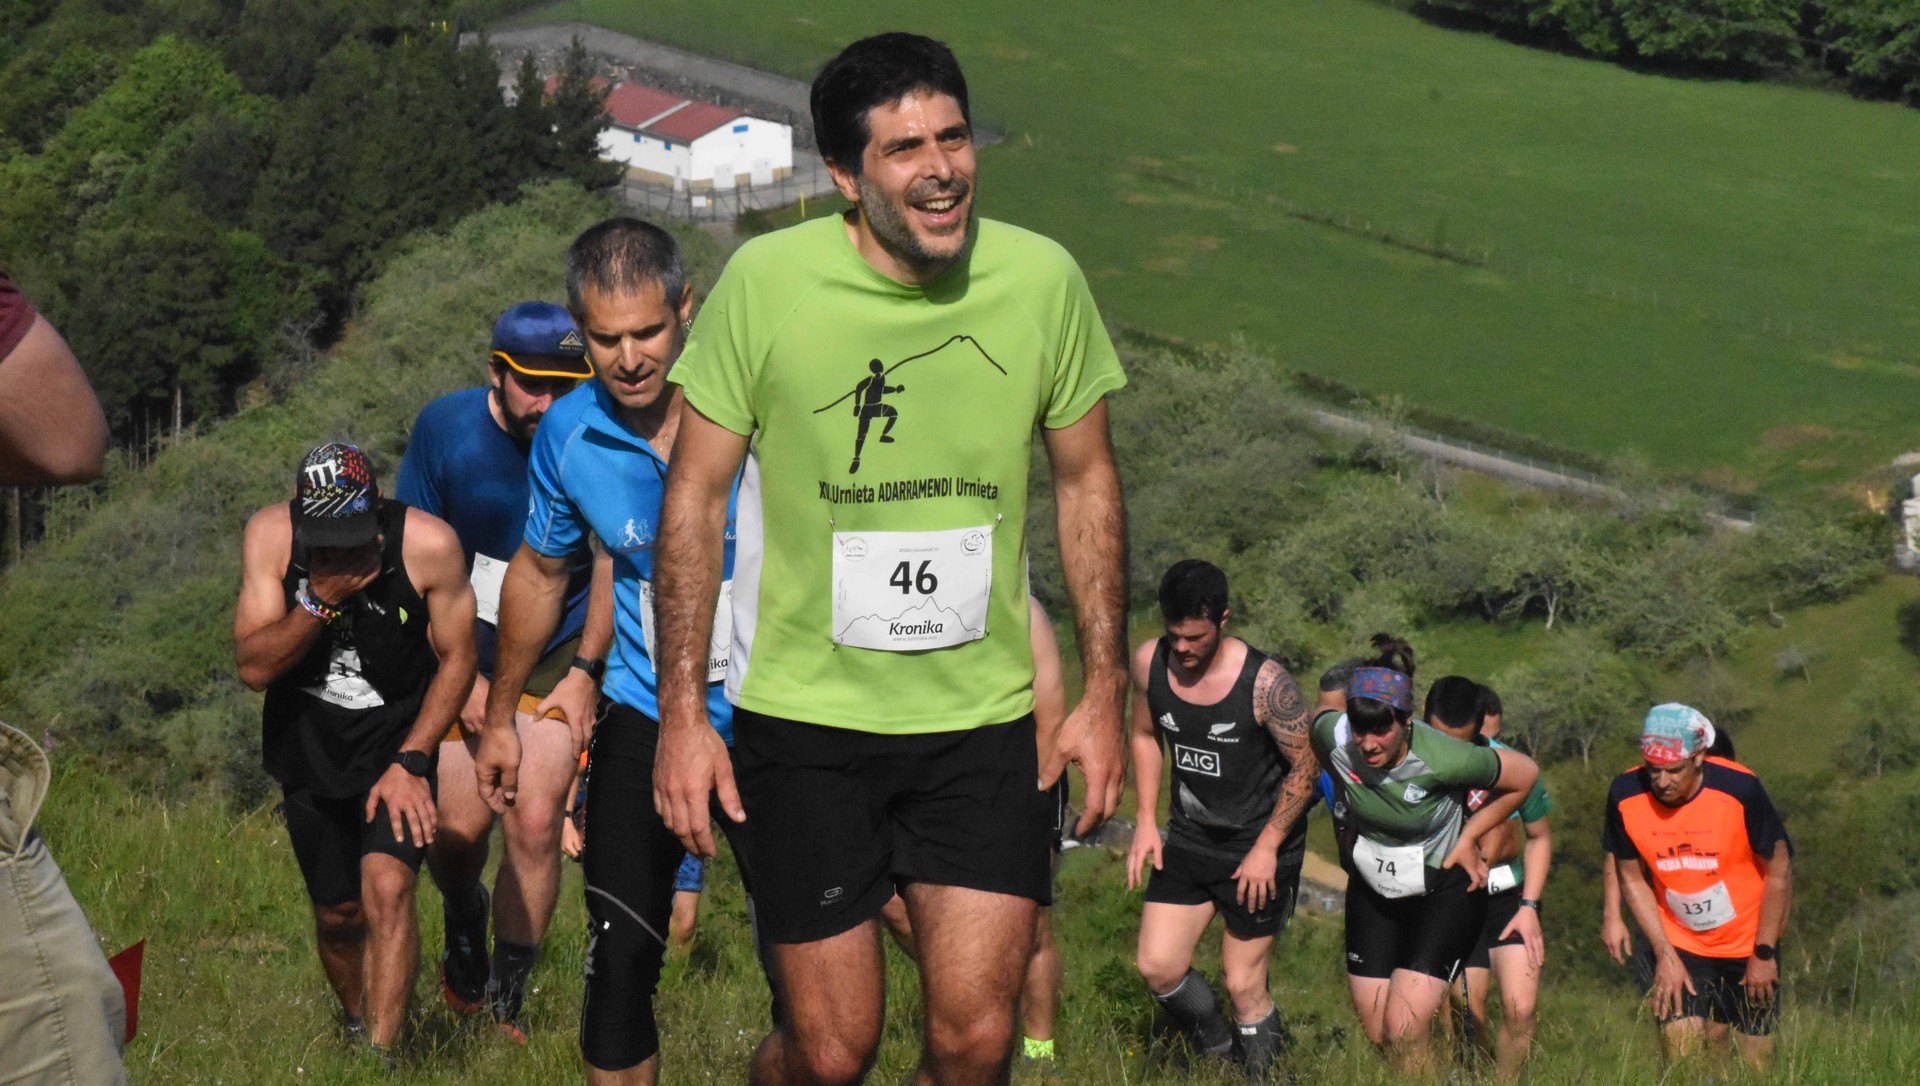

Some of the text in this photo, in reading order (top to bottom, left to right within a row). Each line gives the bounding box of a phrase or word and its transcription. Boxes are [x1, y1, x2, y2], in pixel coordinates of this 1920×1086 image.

[832, 482, 875, 504] Urnieta
[878, 477, 952, 502] ADARRAMENDI
[956, 477, 998, 500] Urnieta
[889, 560, 938, 595] 46
[889, 620, 943, 635] Kronika
[325, 689, 354, 701] ronika
[1181, 751, 1214, 770] AIG
[1376, 857, 1396, 876] 74
[1682, 899, 1712, 915] 137
